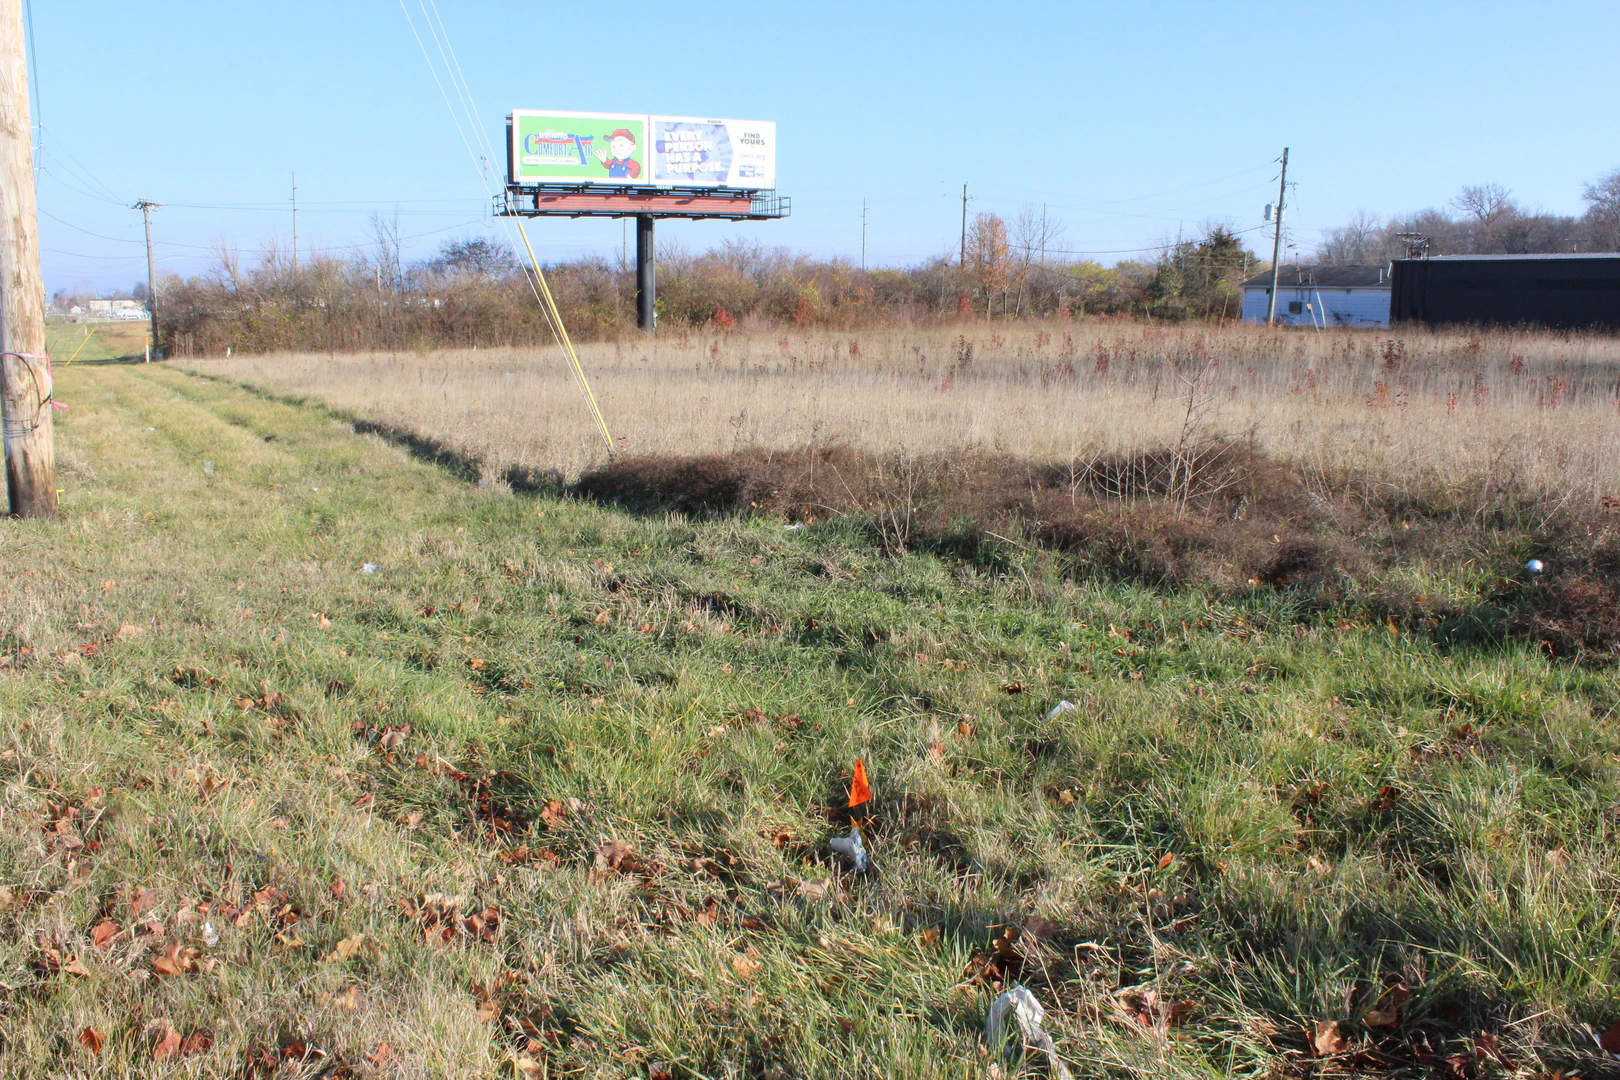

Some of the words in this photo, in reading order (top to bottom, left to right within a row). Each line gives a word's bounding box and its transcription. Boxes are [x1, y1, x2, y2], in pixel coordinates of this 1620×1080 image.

[664, 130, 703, 141] EVERY
[523, 133, 567, 156] COMFORT
[664, 141, 713, 152] PERSON
[740, 138, 765, 146] YOURS
[666, 152, 691, 163] HAS
[692, 151, 703, 162] A
